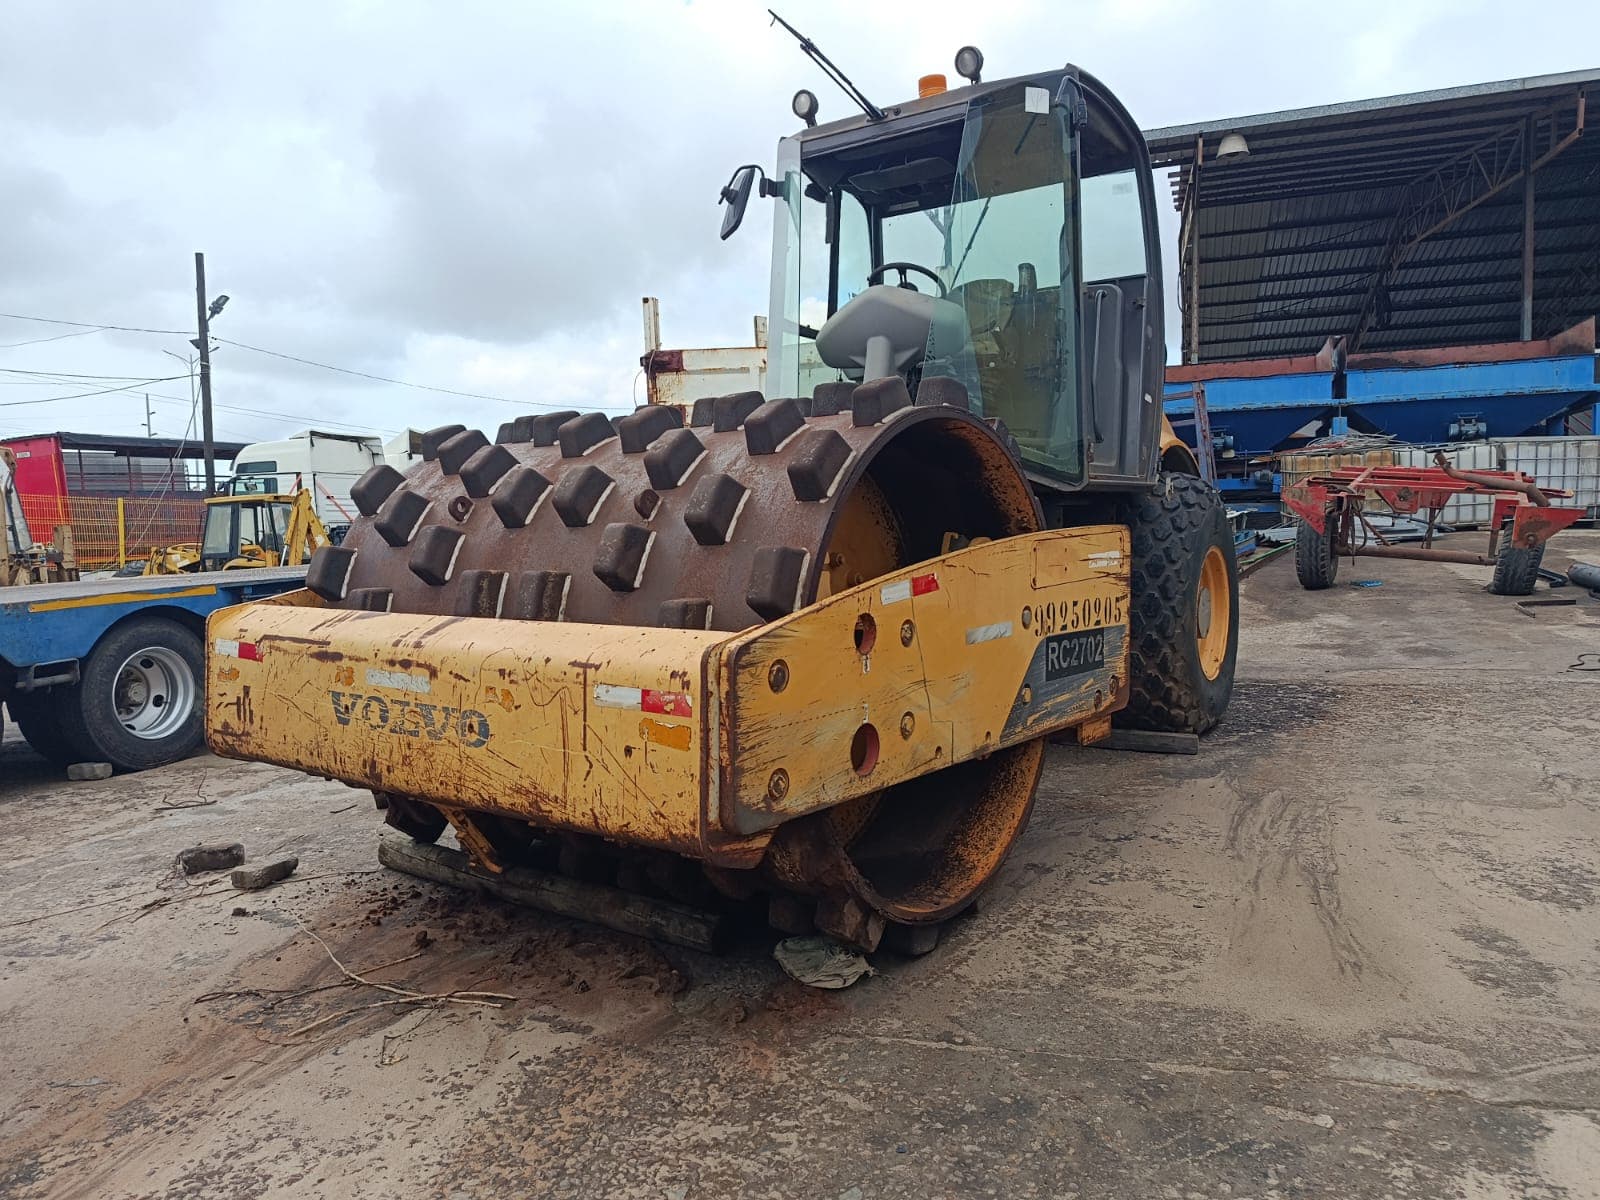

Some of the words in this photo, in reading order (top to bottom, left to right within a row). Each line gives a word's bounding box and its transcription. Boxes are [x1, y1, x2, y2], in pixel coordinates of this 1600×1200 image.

[1034, 596, 1122, 637] 99250205
[1047, 634, 1104, 672] RC2702
[327, 690, 490, 748] VOLVO
